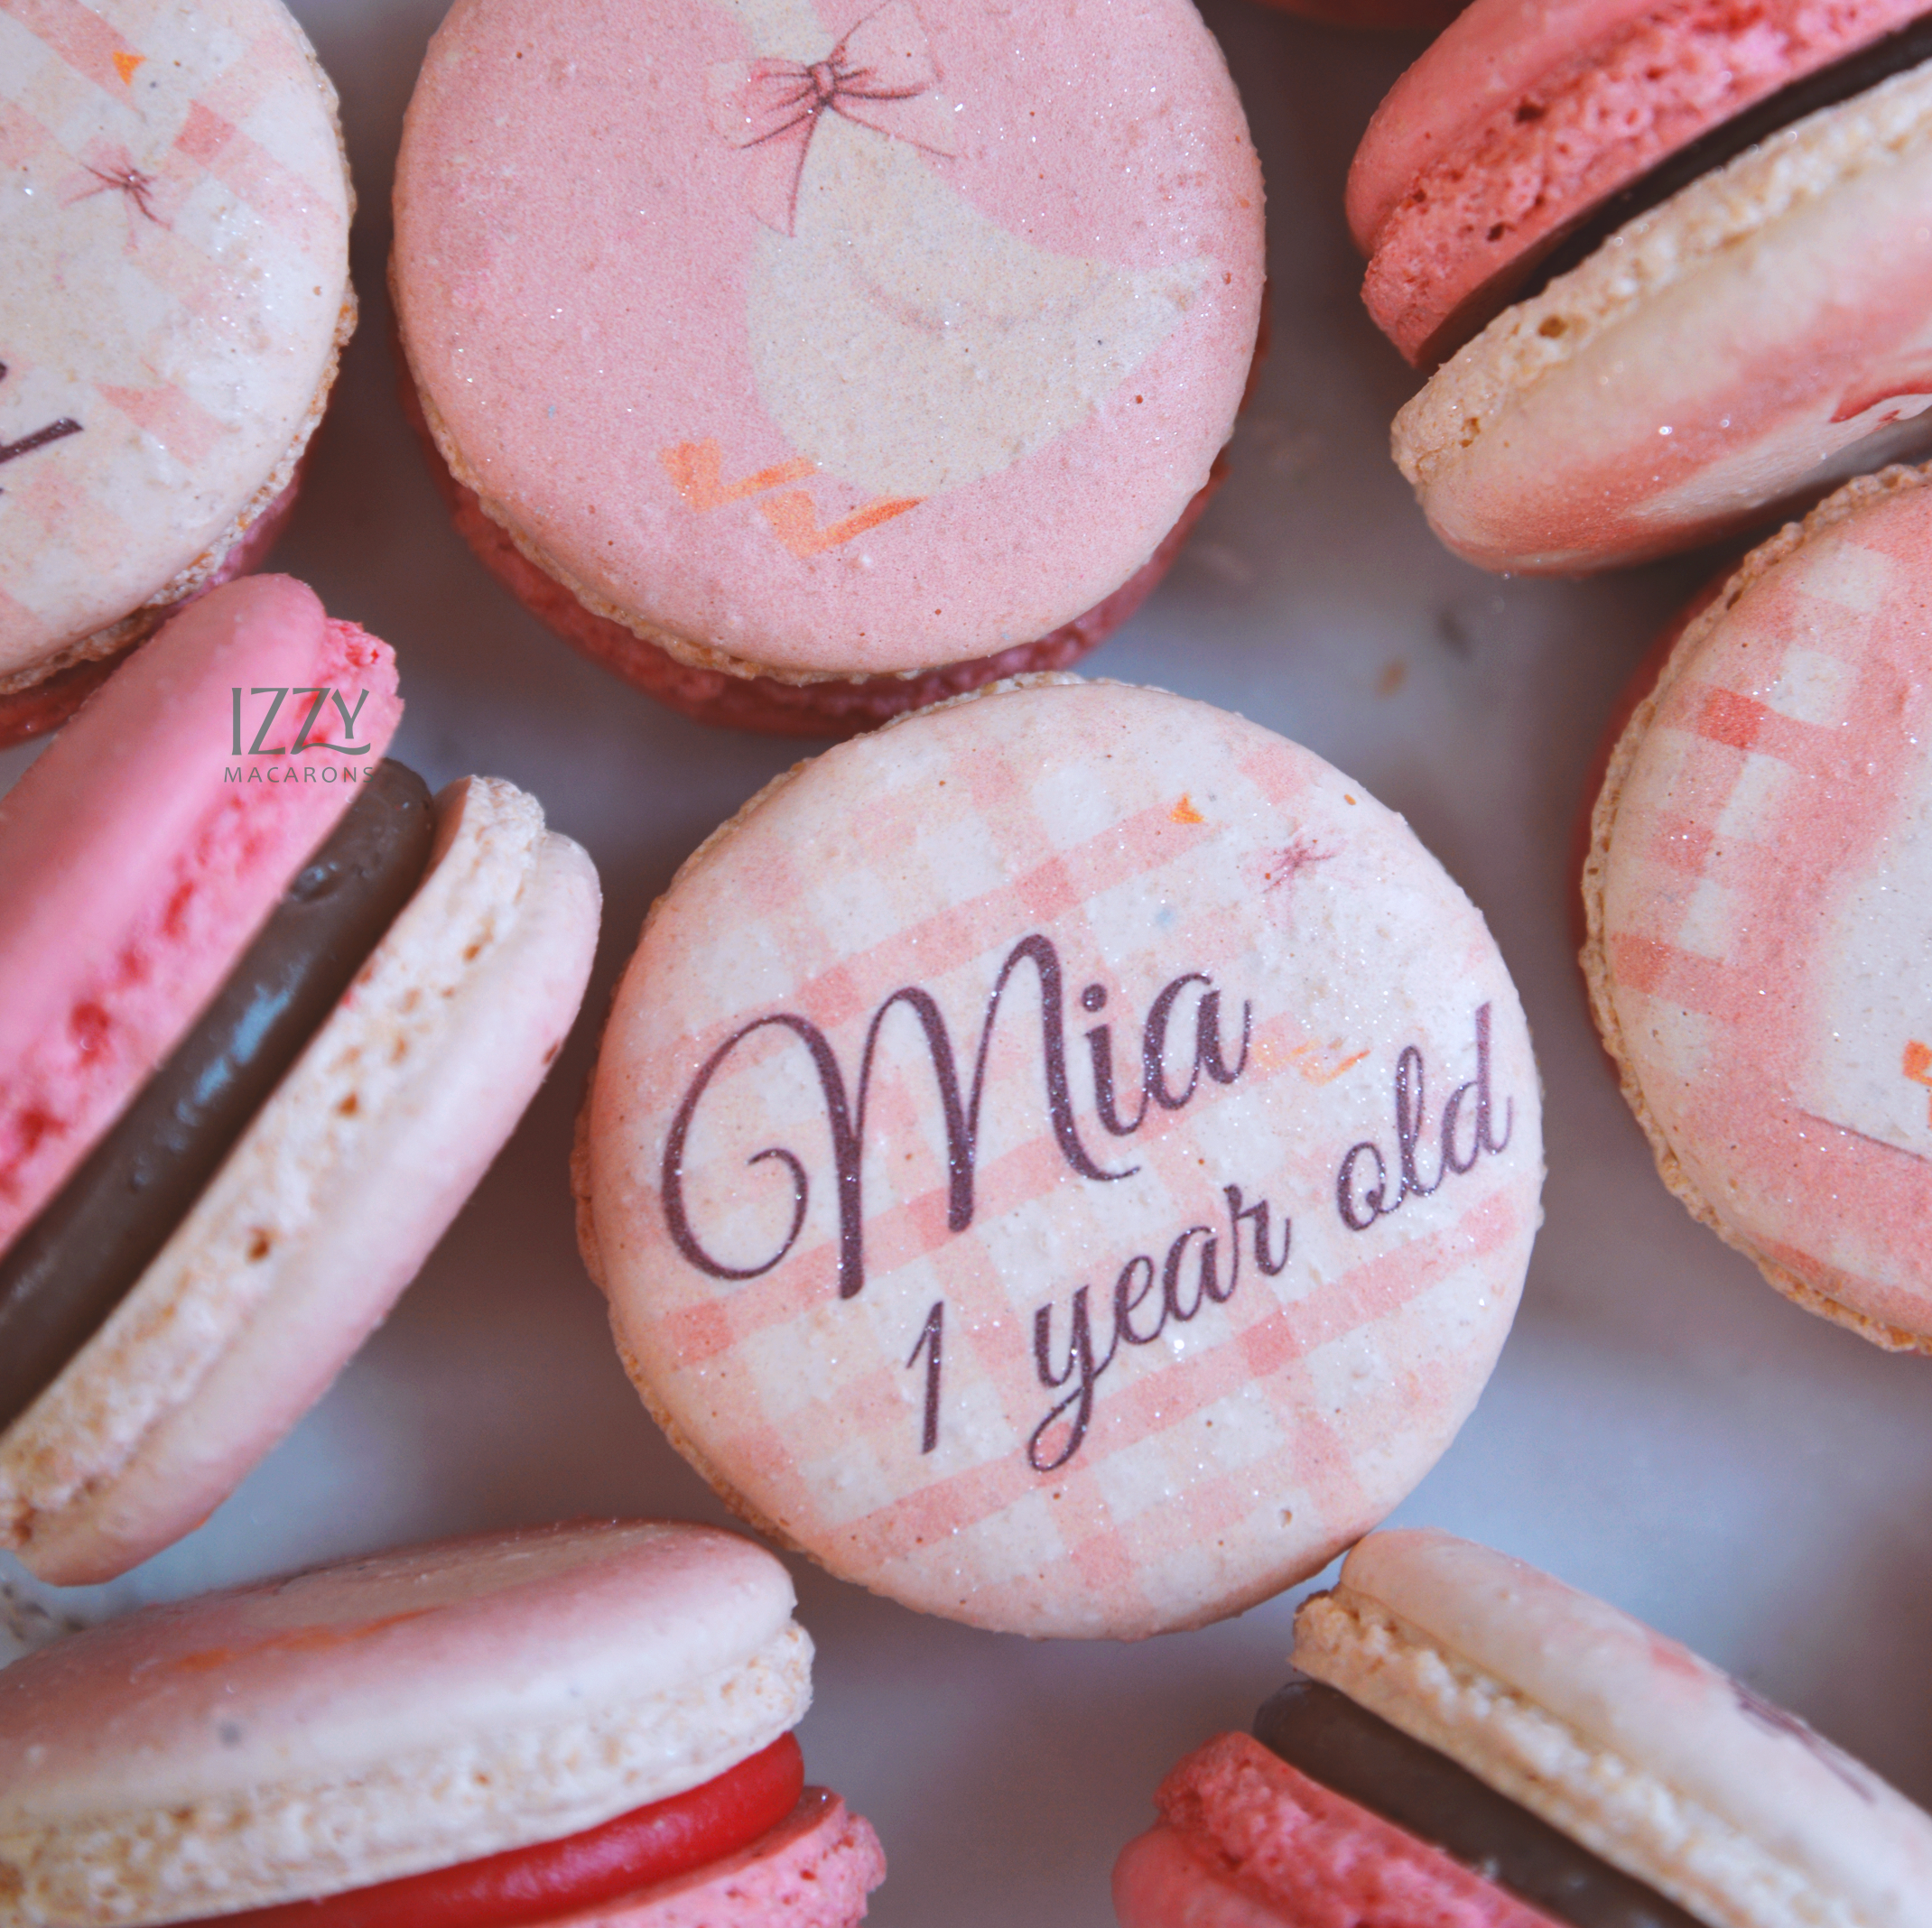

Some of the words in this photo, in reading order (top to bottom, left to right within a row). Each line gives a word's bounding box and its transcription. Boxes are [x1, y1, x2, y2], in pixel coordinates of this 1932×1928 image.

[660, 933, 1252, 1300] Mia
[906, 1301, 944, 1455] 1
[1027, 1184, 1291, 1472] year
[1336, 1001, 1513, 1231] old
